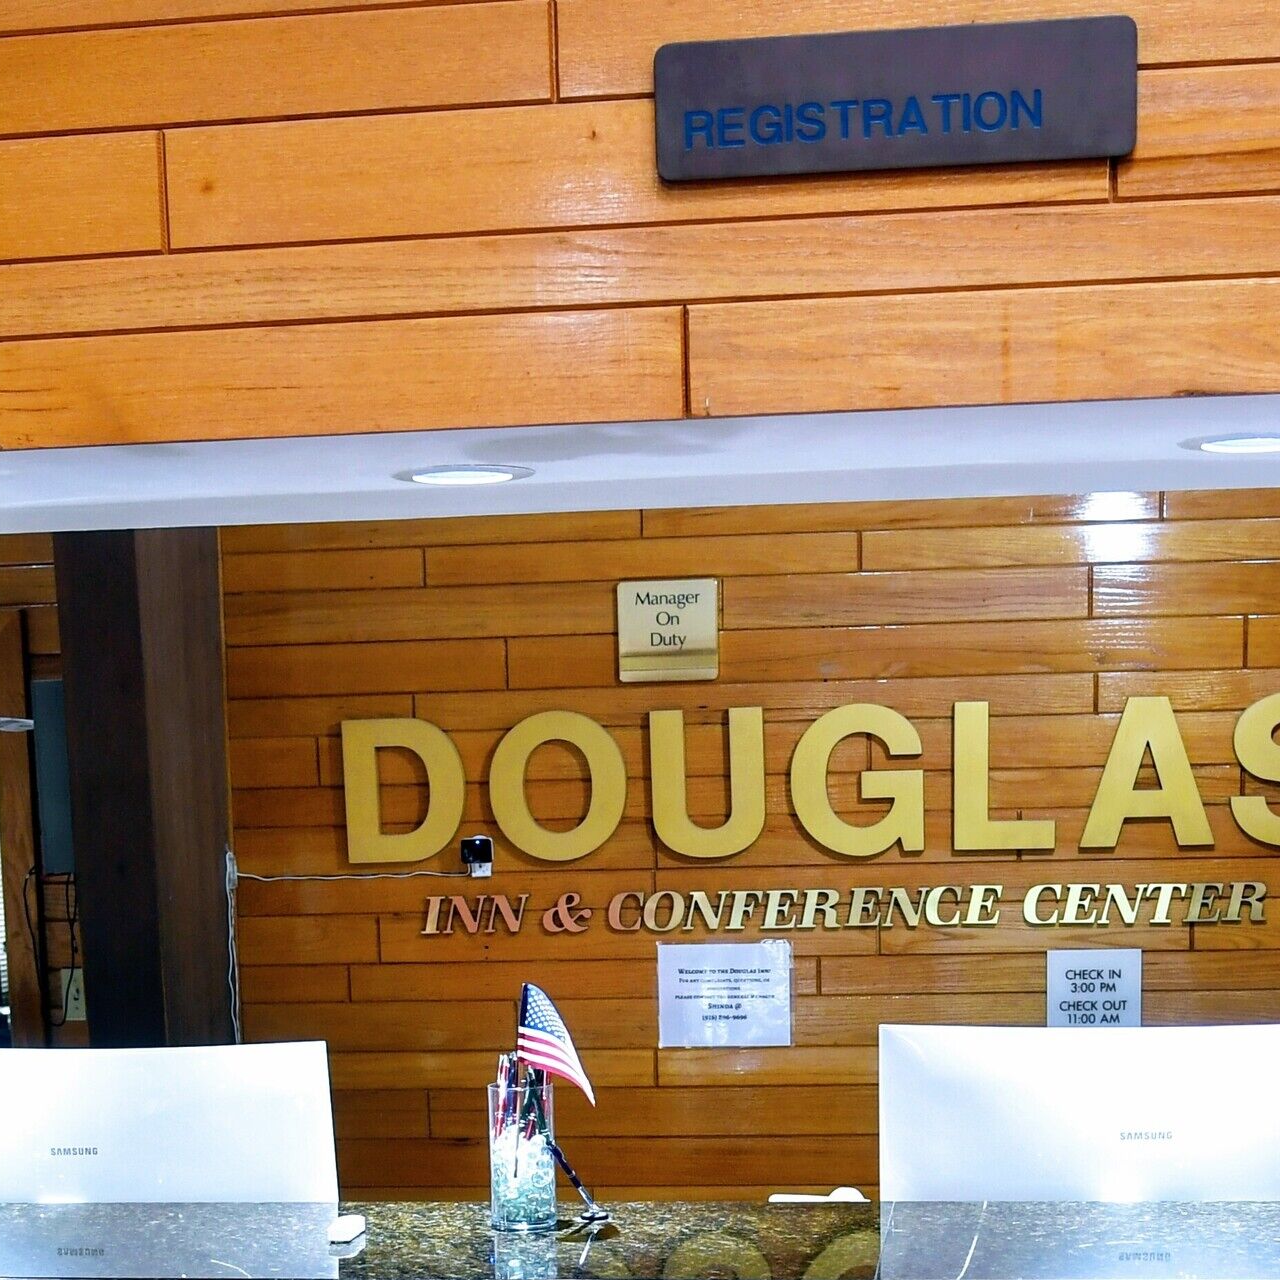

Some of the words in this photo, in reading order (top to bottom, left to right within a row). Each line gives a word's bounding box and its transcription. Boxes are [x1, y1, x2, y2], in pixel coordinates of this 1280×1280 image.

[683, 89, 1043, 150] REGISTRATION
[635, 592, 700, 609] Manager
[656, 611, 680, 626] On
[650, 632, 686, 649] Duty
[422, 893, 529, 935] INN
[543, 891, 593, 934] &
[608, 883, 1004, 931] CONFERENCE
[1023, 881, 1268, 925] CENTER
[1065, 969, 1104, 980] CHECK
[1108, 969, 1122, 979] IN
[1070, 982, 1095, 993] 3:00
[1100, 982, 1117, 993] PM
[1059, 1000, 1098, 1012] CHECK
[1102, 1000, 1127, 1011] OUT
[1067, 1013, 1096, 1024] 11:00
[1100, 1014, 1120, 1024] AM
[1120, 1131, 1173, 1140] SAMSUNG
[50, 1147, 98, 1156] SAMSUNG
